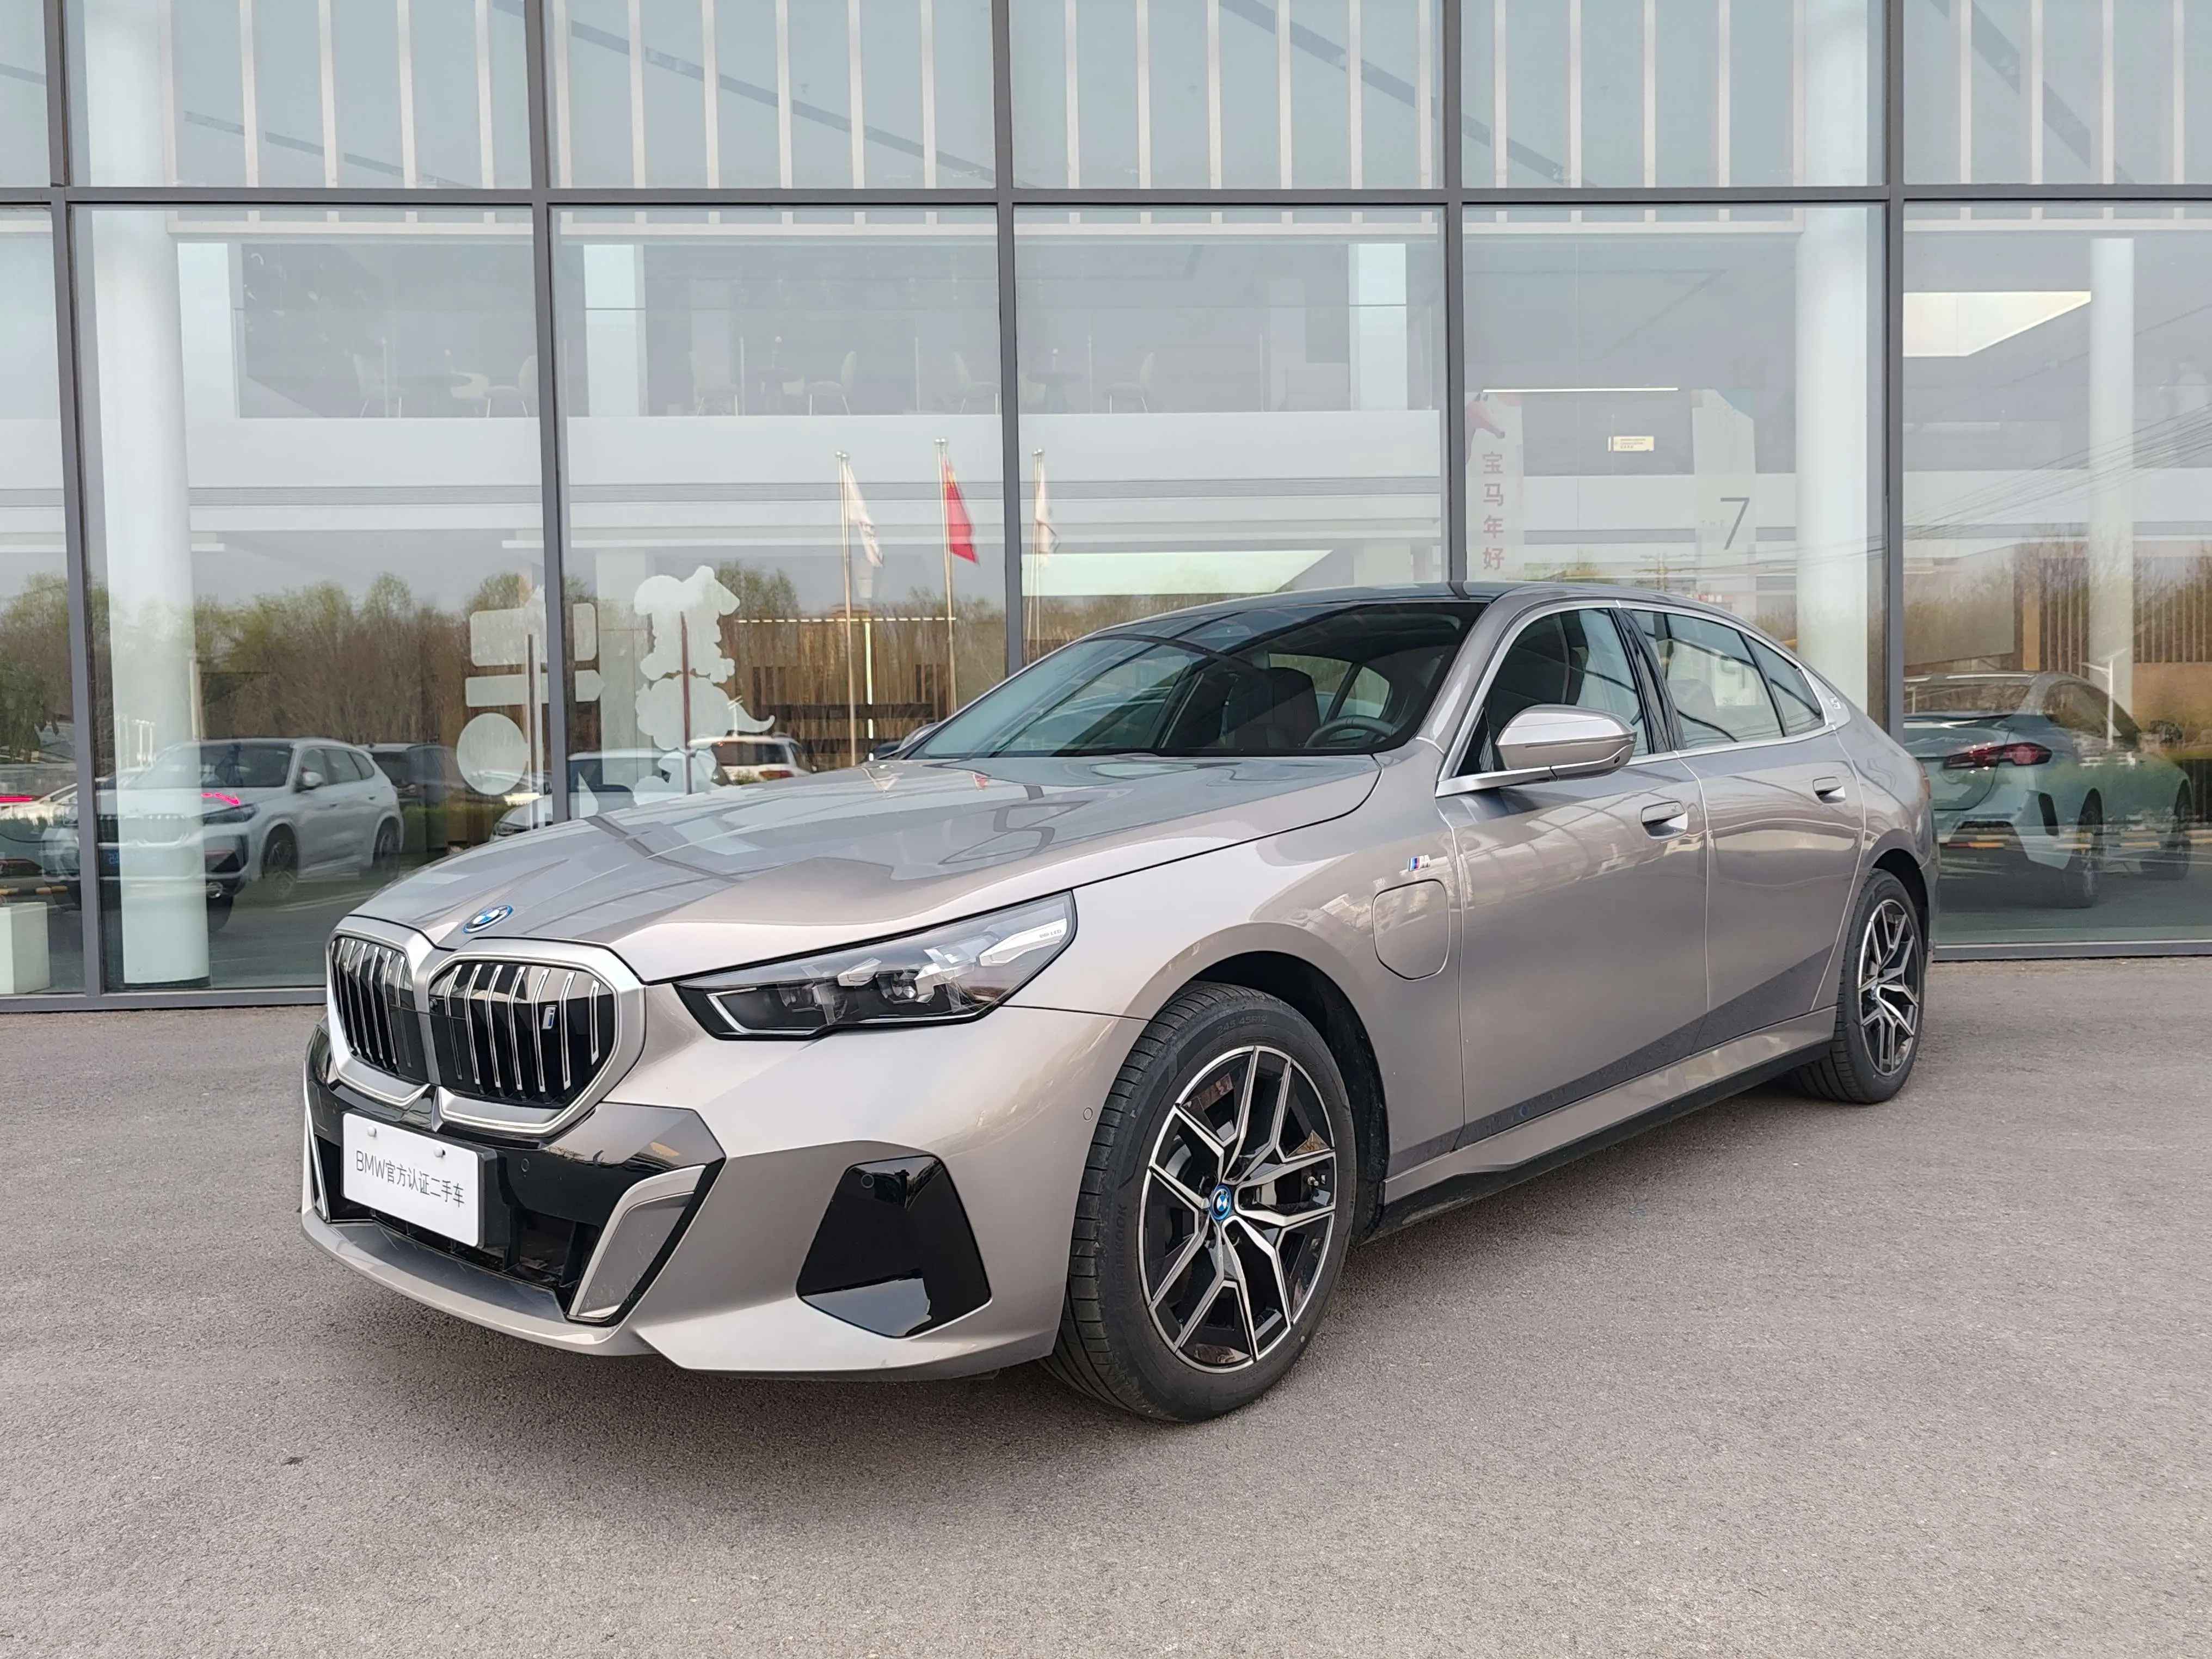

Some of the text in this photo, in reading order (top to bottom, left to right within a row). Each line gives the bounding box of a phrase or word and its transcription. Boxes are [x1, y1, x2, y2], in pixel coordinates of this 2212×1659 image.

[1482, 451, 1504, 570] 宝马年好
[1721, 497, 1749, 550] 7
[356, 1150, 465, 1208] BMW官方认证二手车
